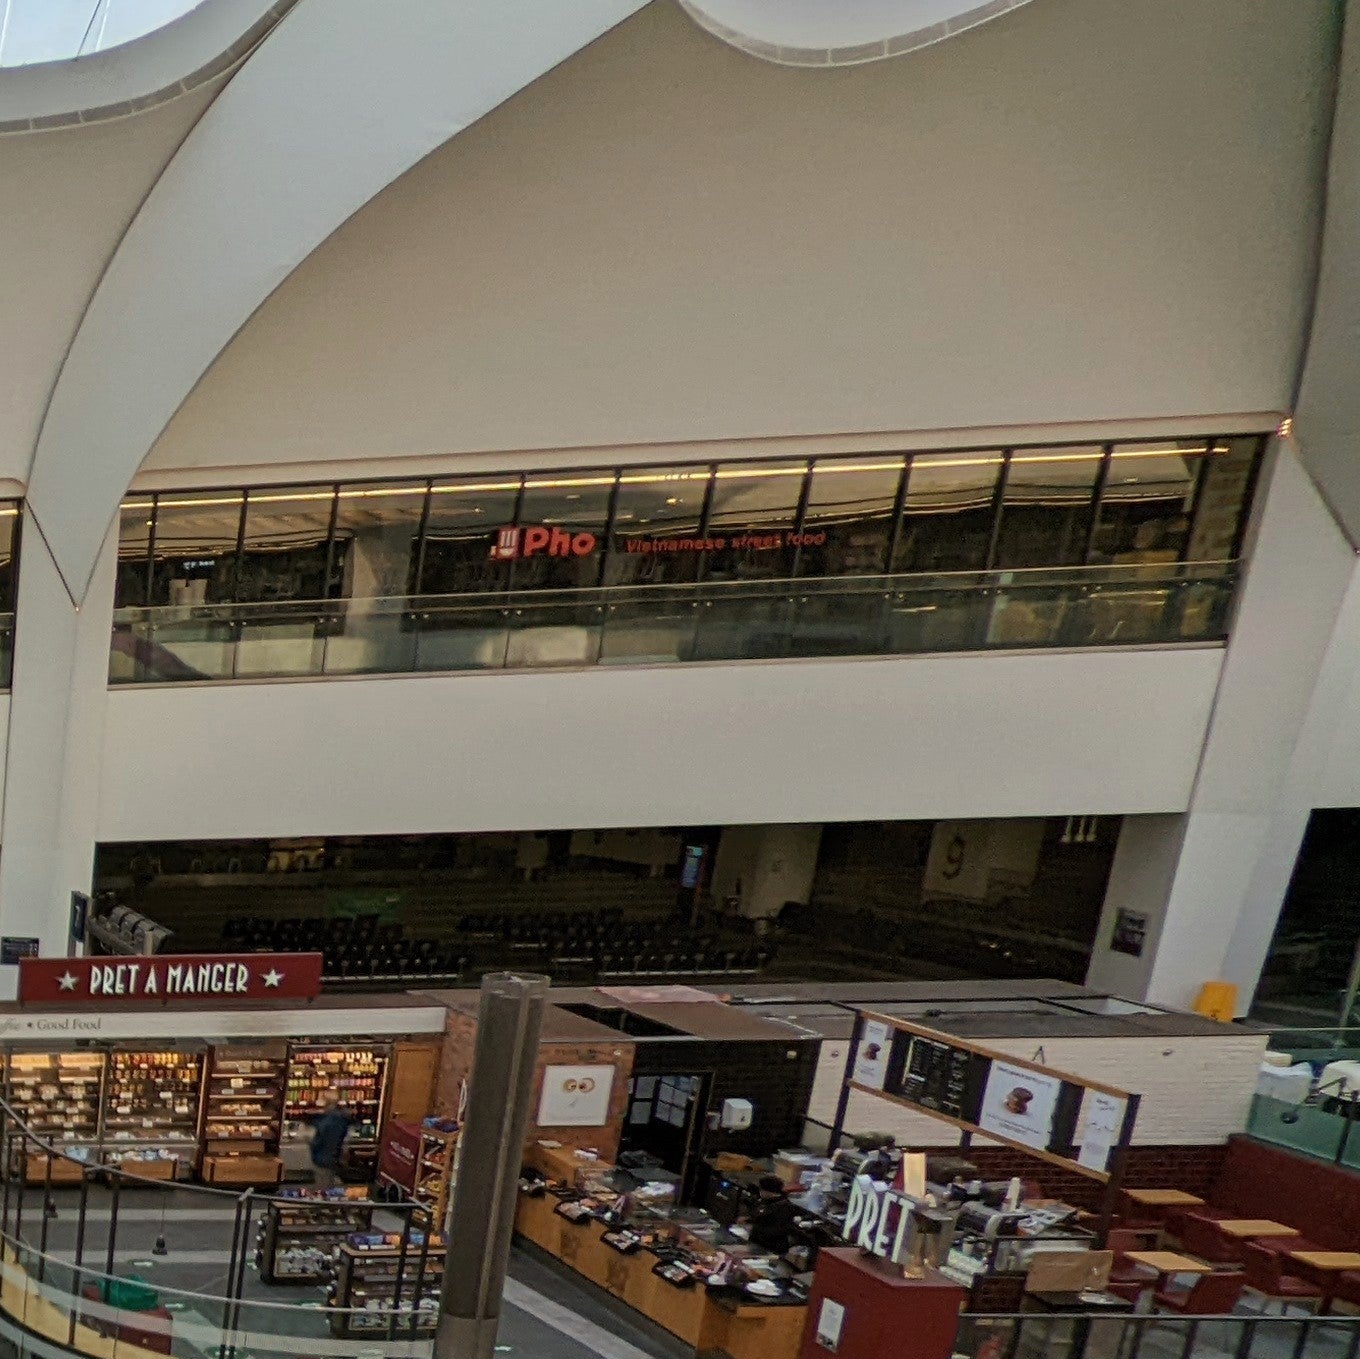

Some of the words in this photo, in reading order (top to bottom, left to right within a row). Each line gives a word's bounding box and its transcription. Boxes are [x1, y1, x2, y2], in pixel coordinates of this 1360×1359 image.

[524, 527, 596, 557] Pho
[627, 537, 725, 553] Vietnamese
[732, 535, 781, 549] street
[787, 532, 826, 546] food
[89, 965, 140, 995] PRET
[144, 967, 157, 994] A
[166, 963, 248, 992] MANGER
[36, 1018, 70, 1030] Good
[72, 1017, 102, 1030] Food
[842, 1176, 916, 1264] PRET
